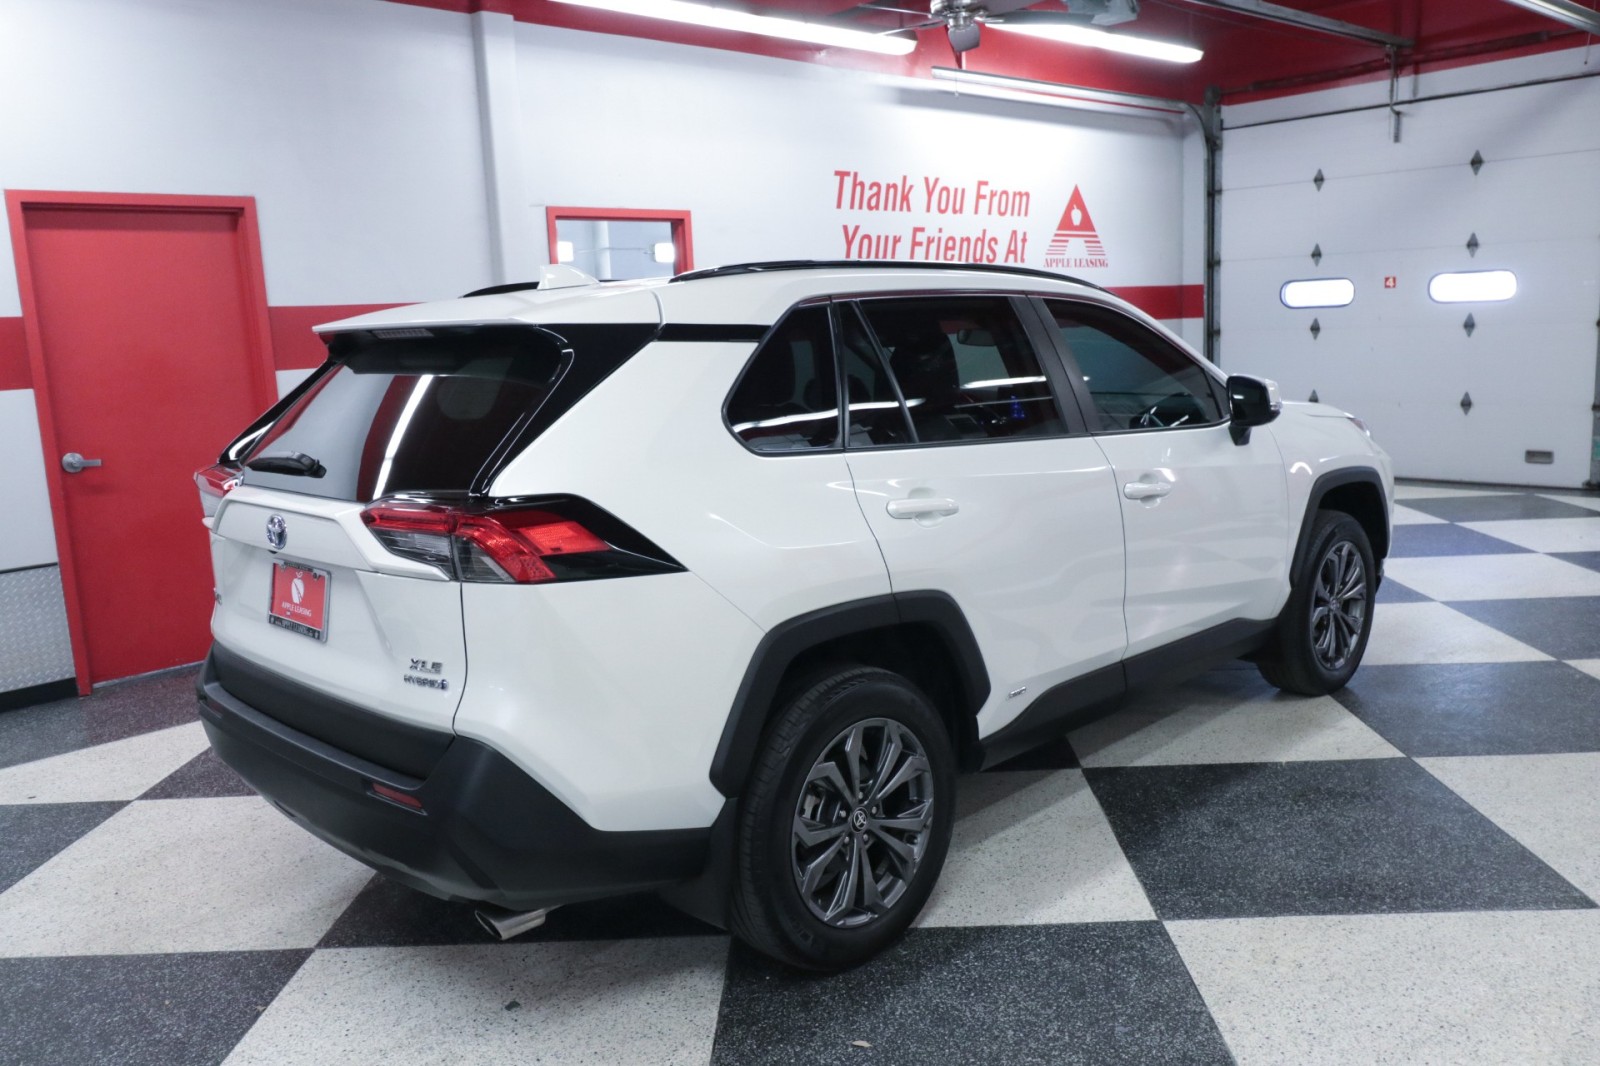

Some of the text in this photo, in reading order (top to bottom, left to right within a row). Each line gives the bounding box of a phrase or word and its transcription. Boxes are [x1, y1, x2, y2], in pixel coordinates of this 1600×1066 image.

[834, 170, 1031, 217] Thank You From
[842, 224, 1028, 264] Your Friends At
[1043, 258, 1109, 269] APPLE LEASING
[282, 601, 295, 612] APPLE
[409, 658, 443, 674] XLE
